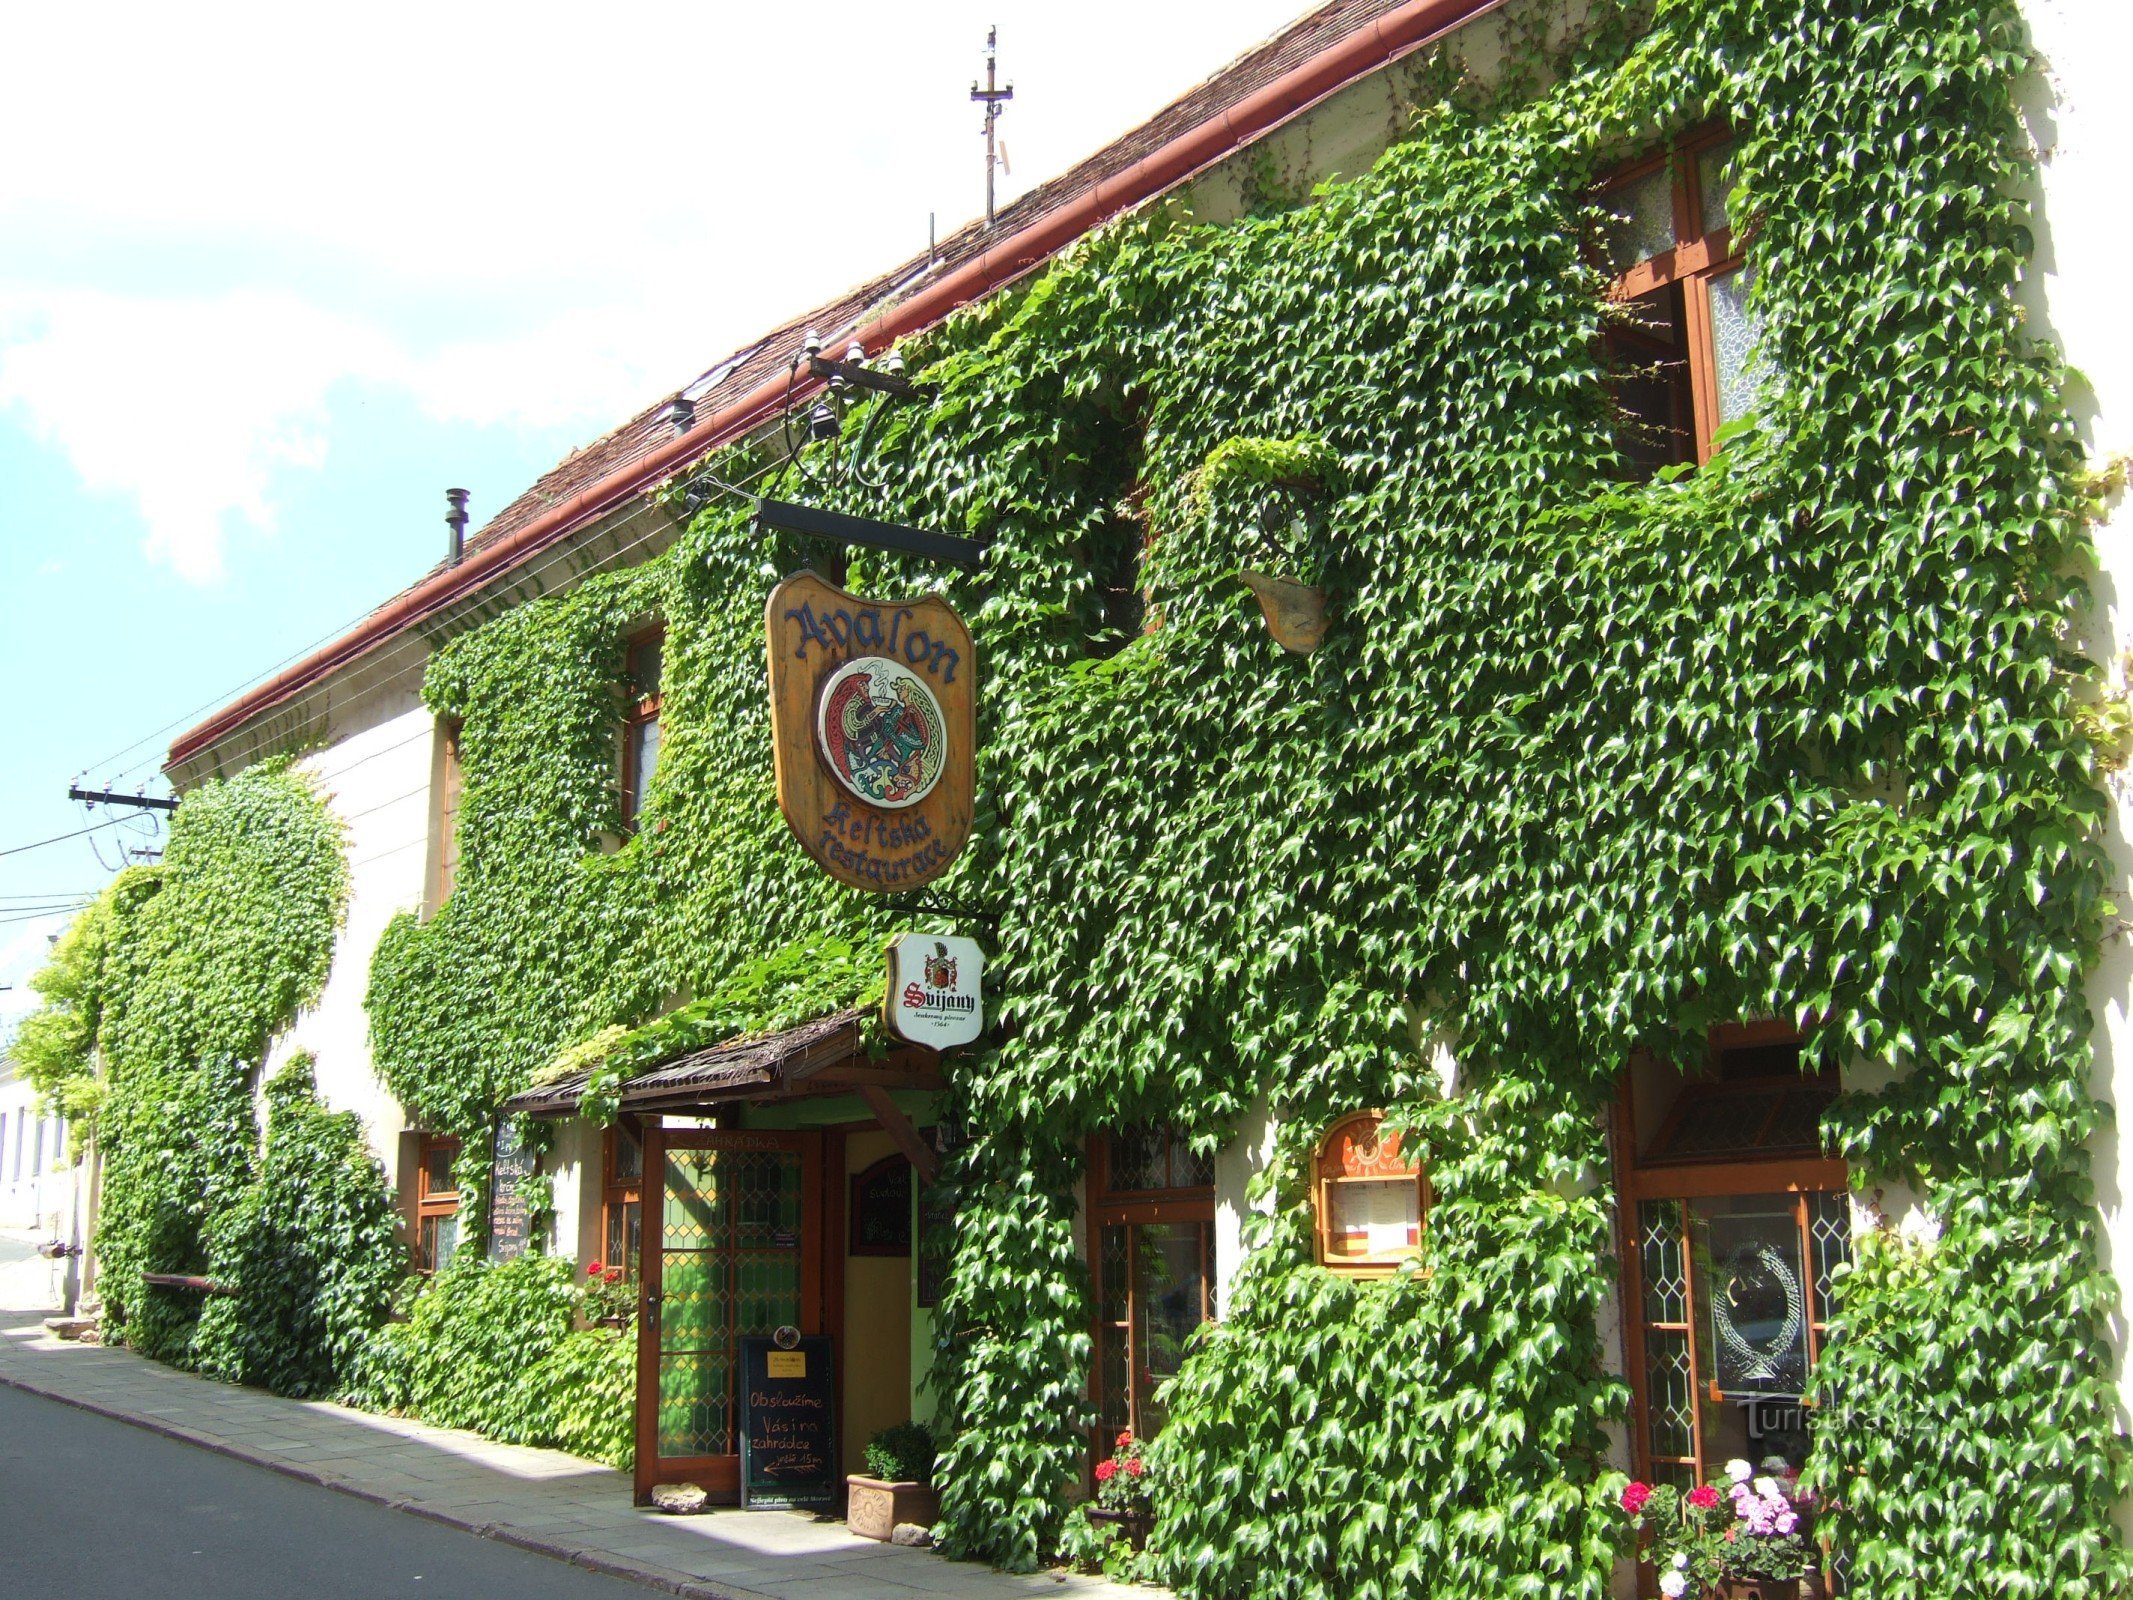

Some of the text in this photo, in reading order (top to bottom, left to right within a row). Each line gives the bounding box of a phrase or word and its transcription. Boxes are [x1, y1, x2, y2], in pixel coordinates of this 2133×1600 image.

[785, 600, 960, 684] Avalon
[819, 829, 948, 883] restaurace
[903, 981, 975, 1014] Svijany
[763, 1416, 788, 1433] Vás
[799, 1422, 819, 1433] na
